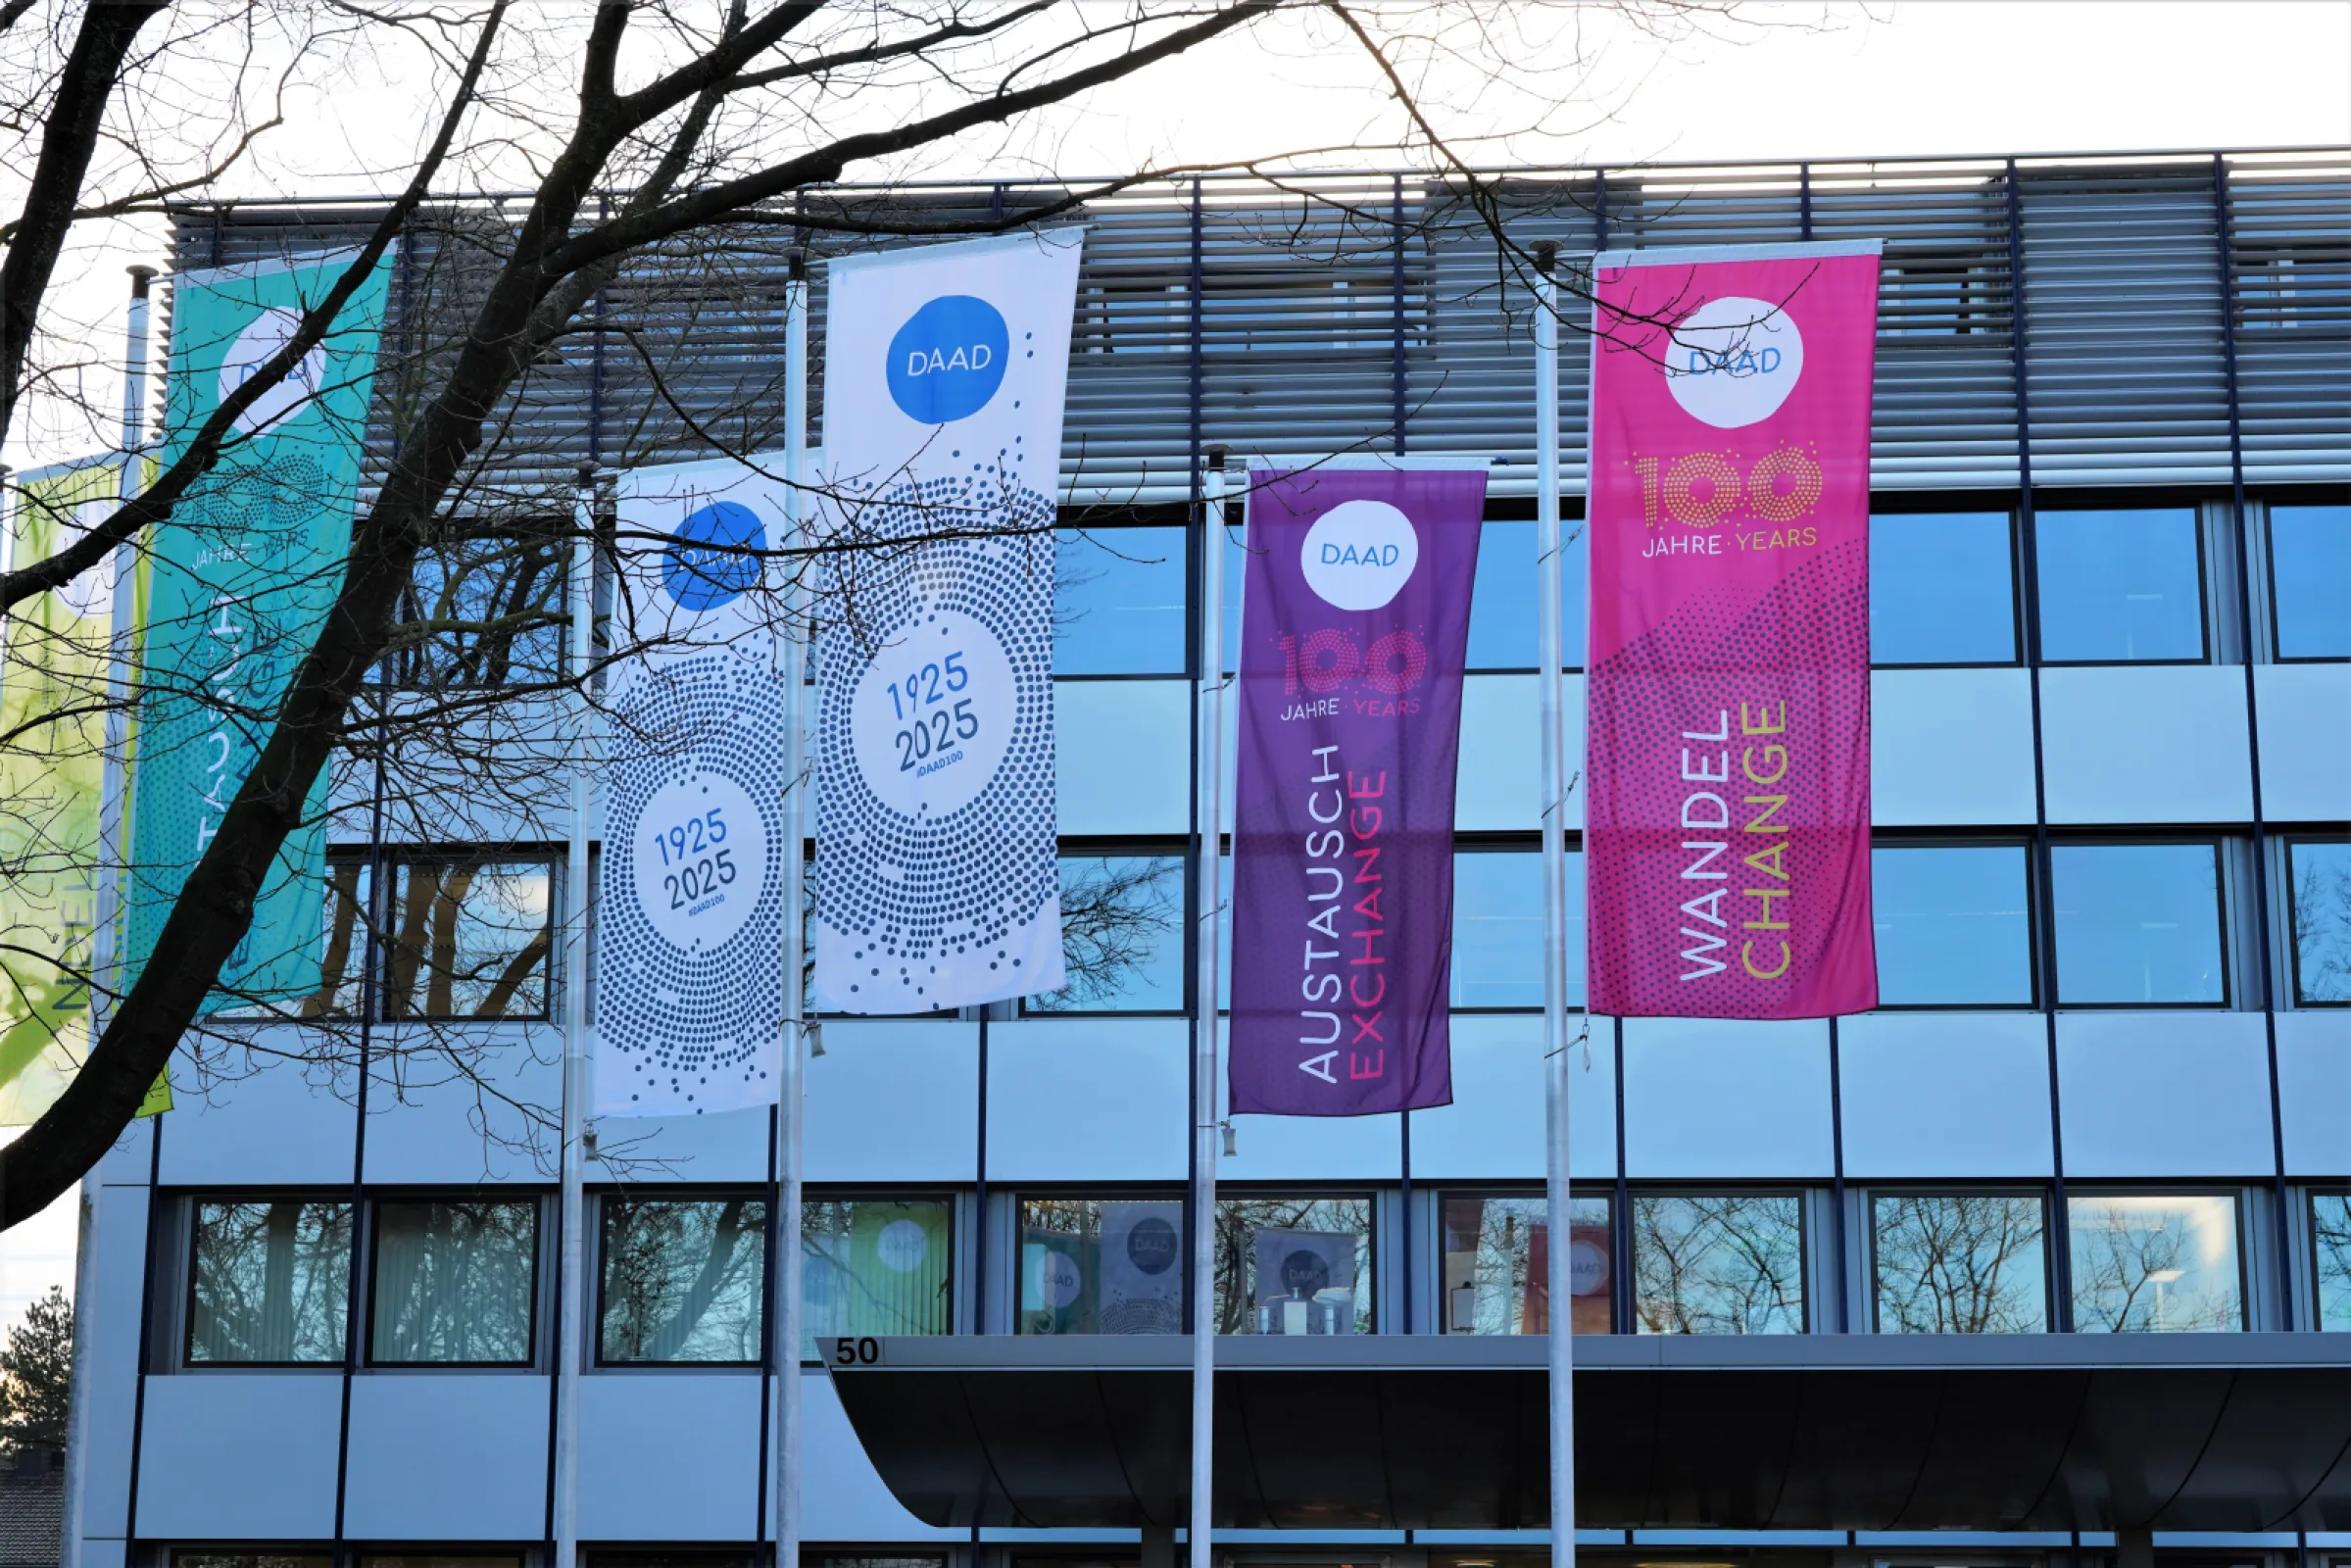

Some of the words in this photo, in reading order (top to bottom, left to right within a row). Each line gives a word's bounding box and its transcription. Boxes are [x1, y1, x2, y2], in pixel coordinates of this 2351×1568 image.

[907, 344, 992, 377] DAAD
[1689, 347, 1782, 376] DAAD
[1635, 445, 1824, 529] 100
[1320, 543, 1399, 566] DAAD
[1641, 534, 1722, 558] JAHRE
[1736, 527, 1818, 551] YEARS
[887, 650, 968, 720] 1925
[1278, 627, 1427, 697] 100
[896, 698, 979, 772] 2025
[1280, 698, 1341, 721] JAHRE
[1352, 697, 1420, 717] YEARS
[655, 808, 727, 866] 1925
[1680, 710, 1729, 981] WANDEL
[1740, 699, 1791, 980] CHANGE
[663, 849, 737, 910] 2025
[1298, 745, 1345, 1084] AUSTAUSCH
[1347, 770, 1387, 1081] EXCHANGE
[836, 1337, 879, 1365] 50
